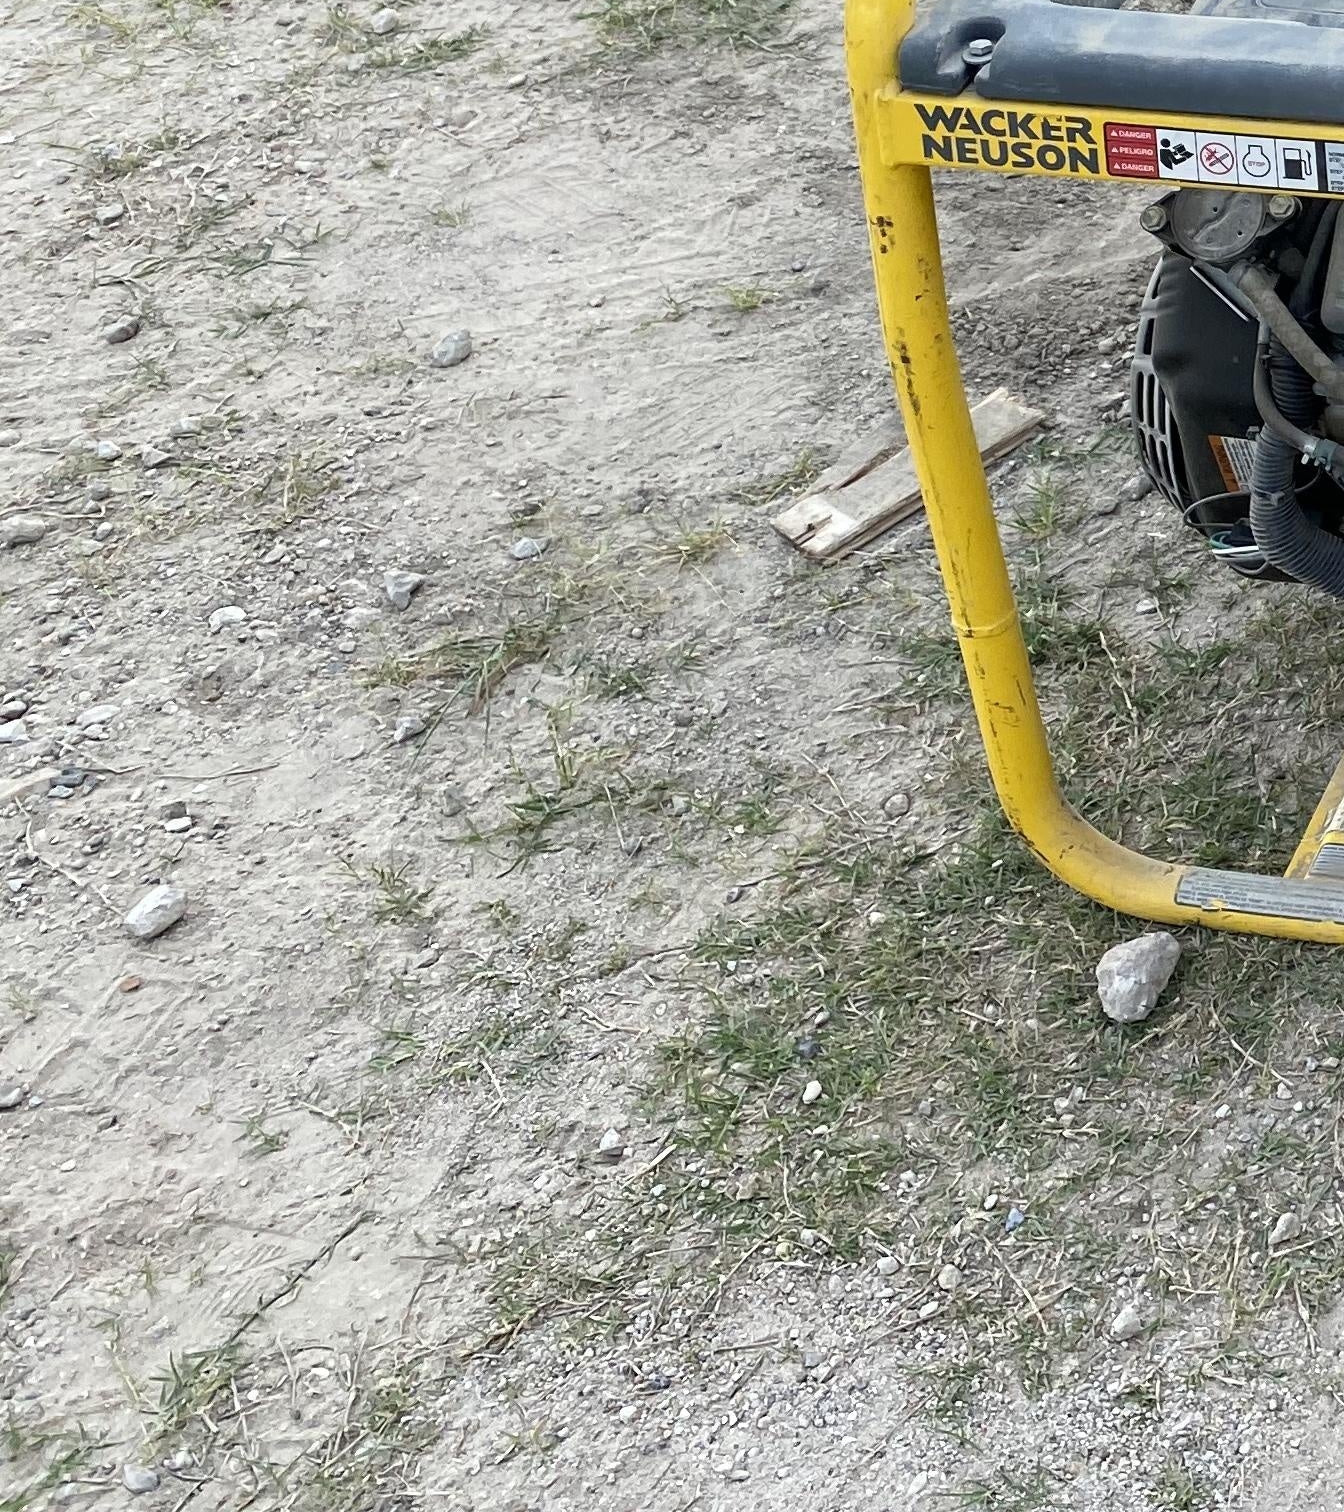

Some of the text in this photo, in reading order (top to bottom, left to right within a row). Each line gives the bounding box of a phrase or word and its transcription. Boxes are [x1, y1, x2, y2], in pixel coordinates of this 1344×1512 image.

[913, 103, 1098, 145] WACKER
[1118, 130, 1151, 140] DANGER
[921, 134, 1101, 175] NEUSON
[1119, 146, 1154, 156] PELIGRO
[1121, 162, 1155, 173] DANGER
